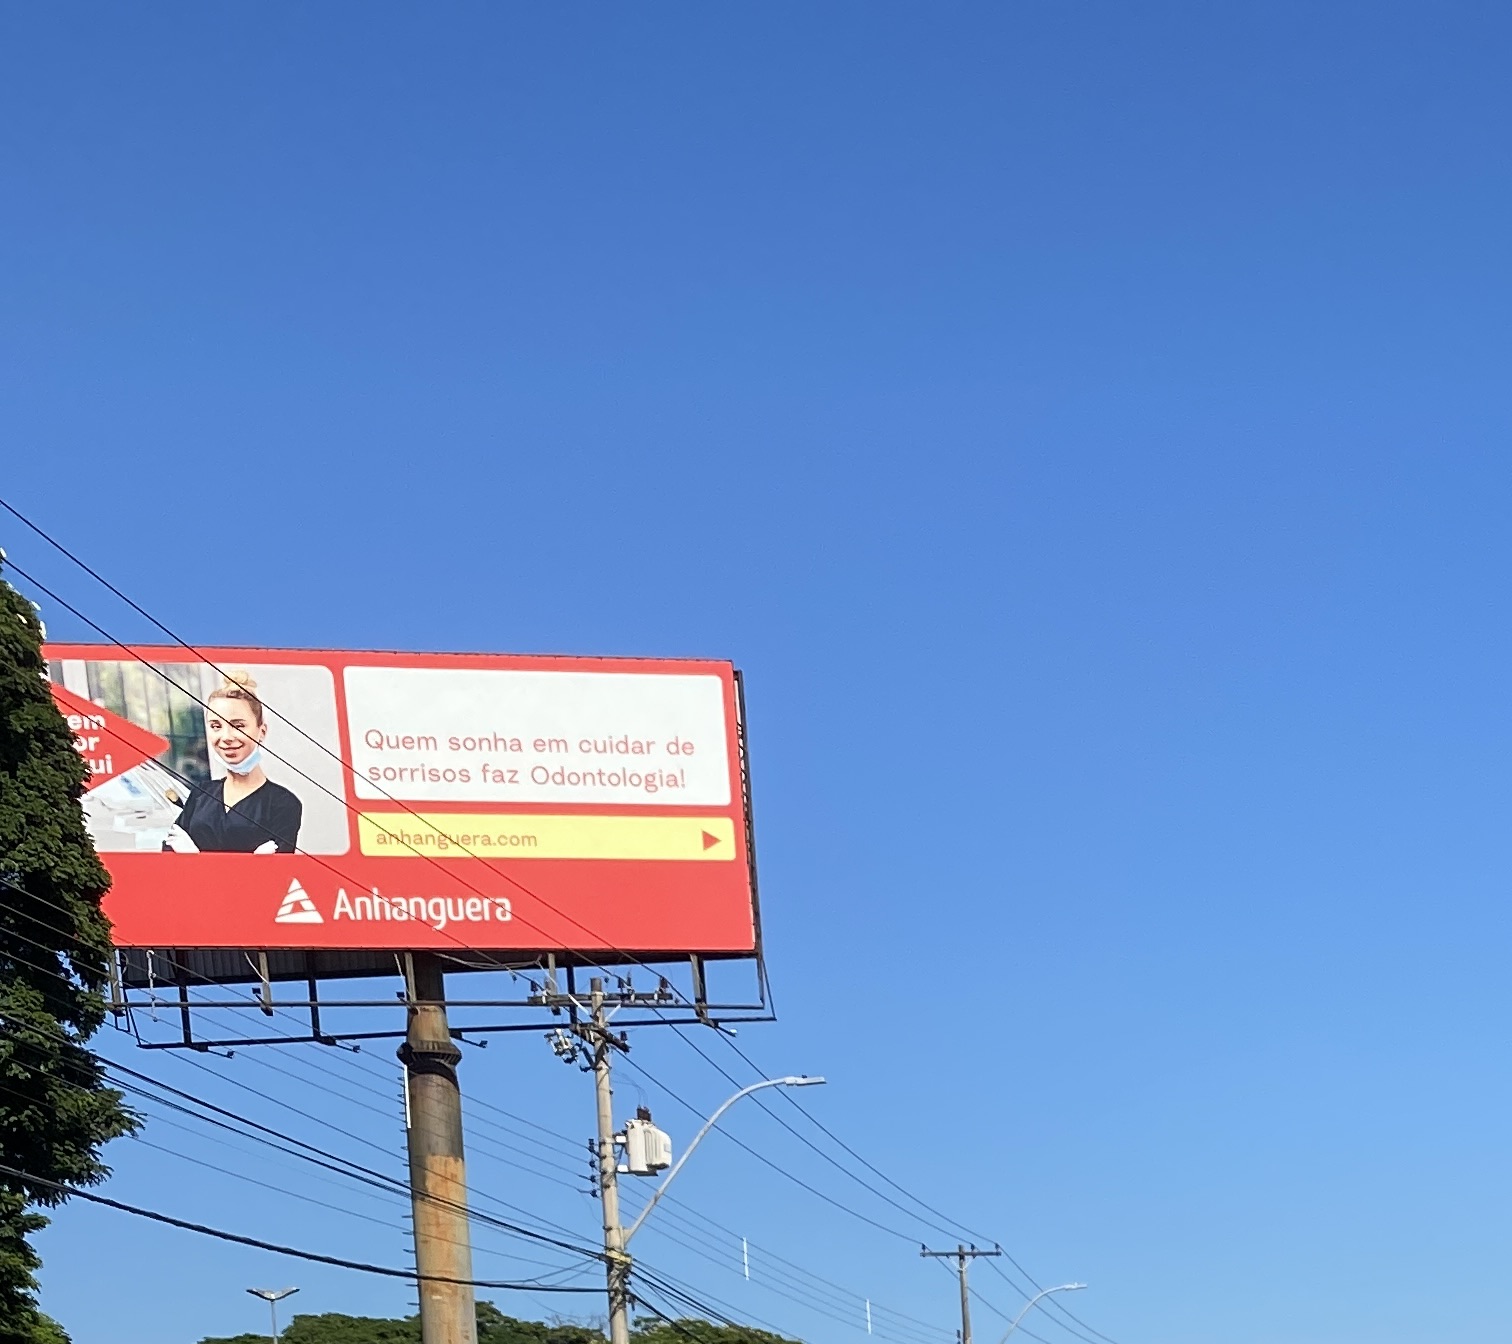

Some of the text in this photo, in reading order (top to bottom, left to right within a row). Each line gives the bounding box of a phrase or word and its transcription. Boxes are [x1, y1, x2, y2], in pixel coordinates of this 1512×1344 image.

[63, 714, 105, 730] em
[72, 736, 100, 752] or
[364, 729, 695, 756] Quem sonha em cuidar de
[368, 763, 686, 793] sorrisos faz Odontologia!
[376, 830, 538, 849] anhanguera.com
[333, 887, 512, 930] Anhanguera
